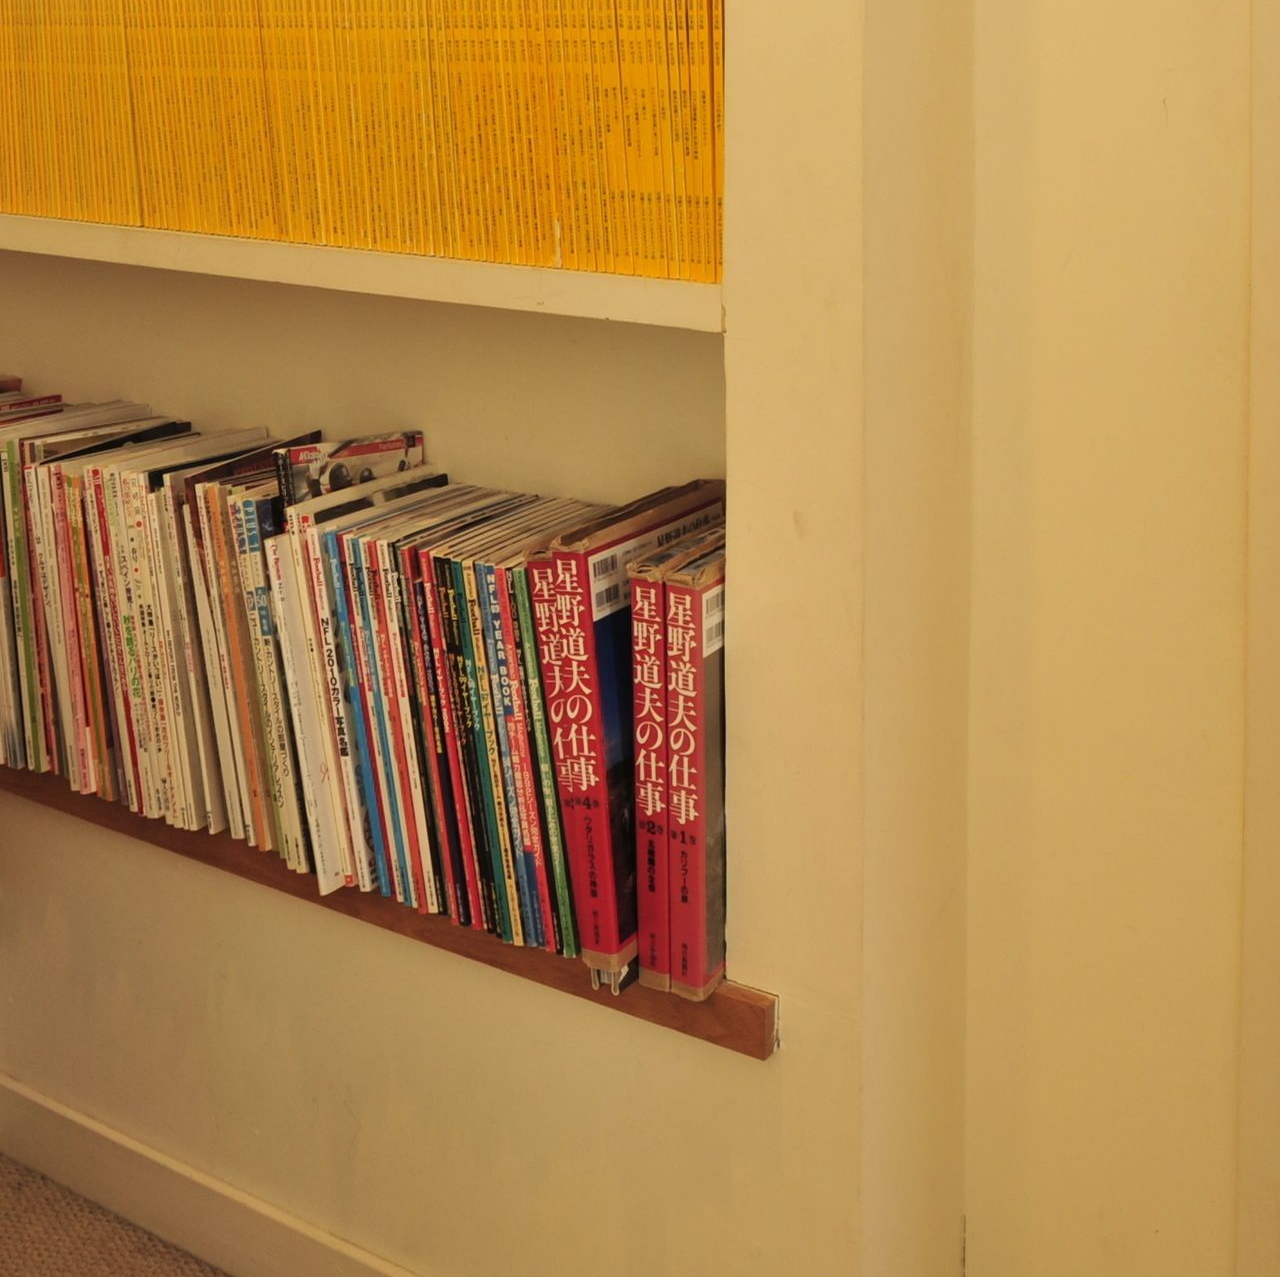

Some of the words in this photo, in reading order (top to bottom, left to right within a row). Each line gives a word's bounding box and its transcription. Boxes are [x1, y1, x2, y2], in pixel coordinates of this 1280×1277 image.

[492, 620, 506, 660] YEAR
[499, 666, 512, 706] BOOK
[555, 559, 600, 792] 星野道夫の仕事
[633, 586, 666, 817] 星野道夫の仕事
[667, 593, 700, 825] 星野道夫の仕事
